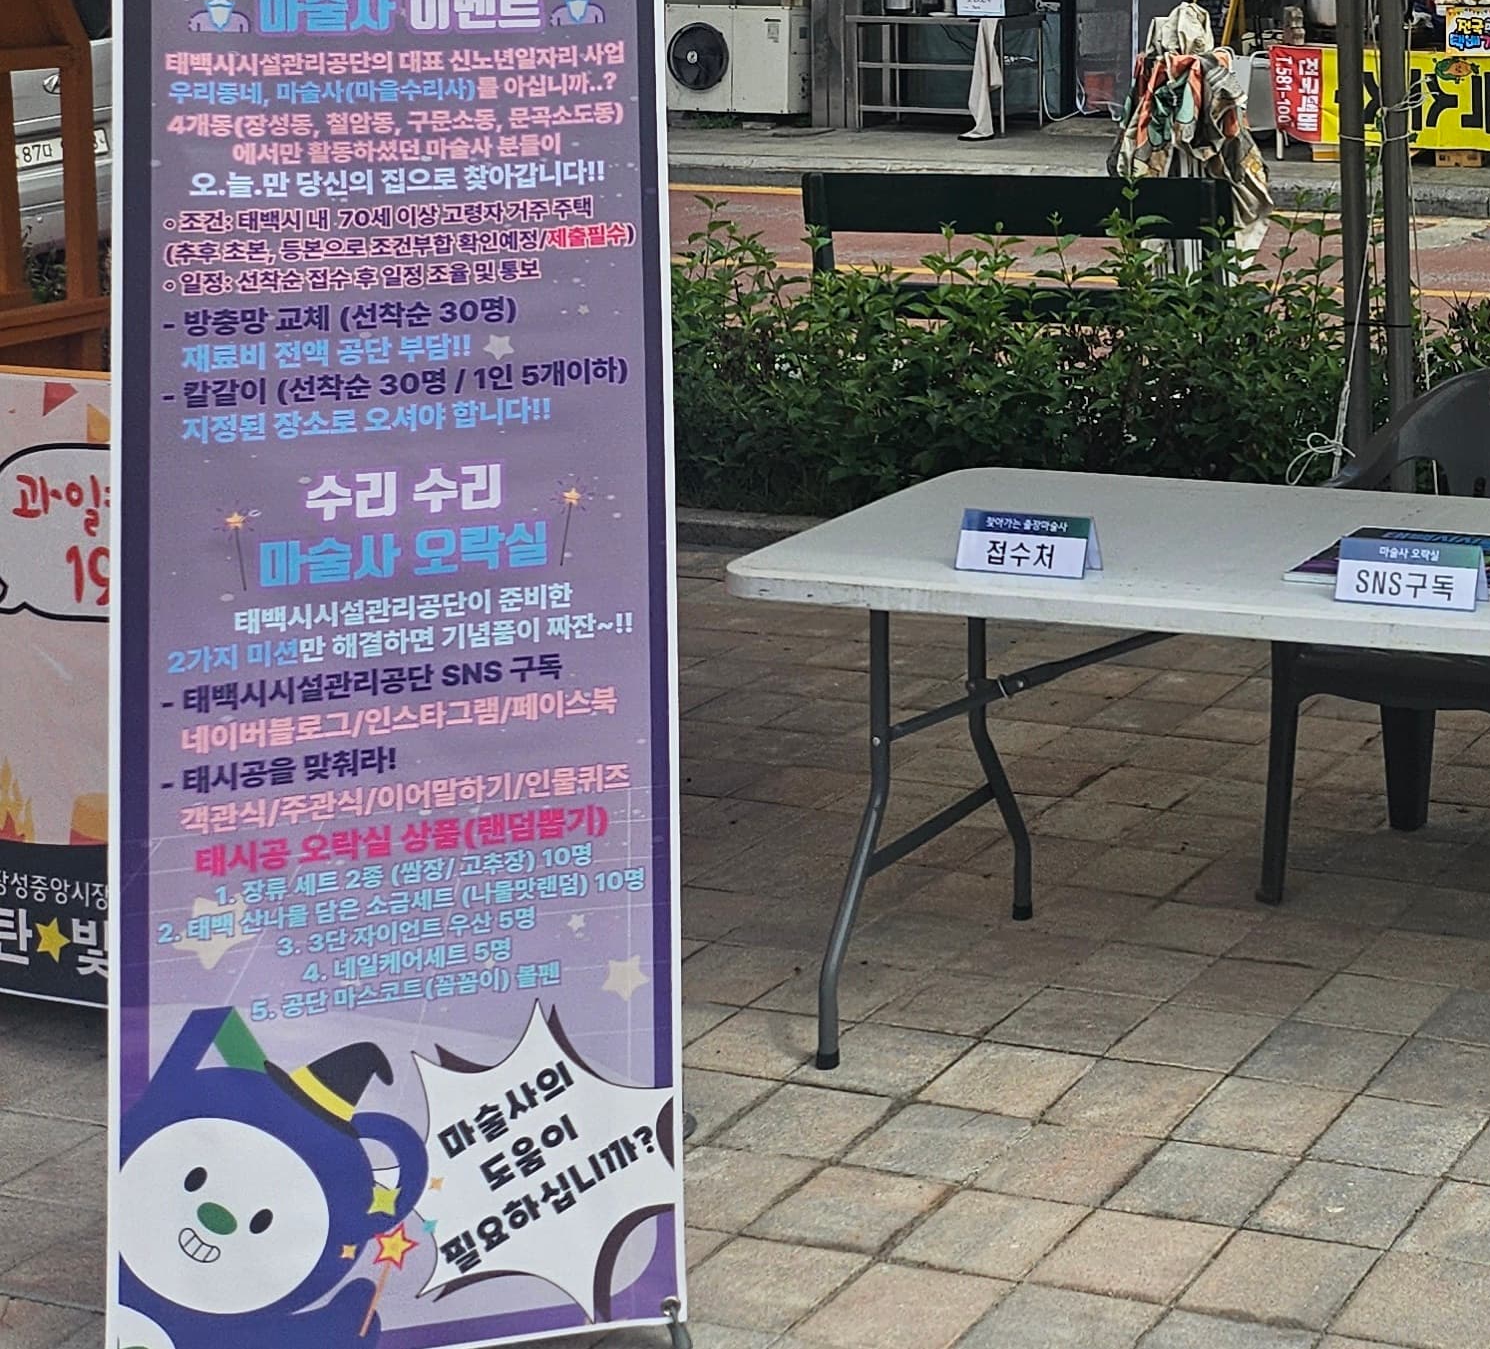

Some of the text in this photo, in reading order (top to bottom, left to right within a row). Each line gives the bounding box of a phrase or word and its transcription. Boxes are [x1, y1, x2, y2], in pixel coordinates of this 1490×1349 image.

[165, 41, 625, 77] 태백시시설관리공단의 대표 신노년일자리 사업
[168, 72, 617, 107] 우리동네, 마술사(마을수리사)를 아십니까..?
[1274, 56, 1295, 128] T.581-100
[166, 102, 624, 138] 4개동(장성동, 철암동, 구문소동, 문곡소도동)
[232, 133, 561, 166] 에서만 활동하셨던 마술사 분들이
[189, 159, 606, 198] 오.늘.만 당신의 집으로 찾아갑니다!!
[179, 195, 593, 233] 조건: 태백시 70세 이상 고령자 주택
[165, 223, 637, 266] (추후 초본, 등본으로 조건부합 확인예정/제출필수)
[180, 258, 541, 295] 일정: 선착순 접수 조율 통보
[183, 295, 517, 337] 방충망 교체 (선착순 30명)
[181, 333, 471, 373] 재료비 전액 공단 부담!!
[183, 356, 628, 408] 칼갈이 (선착순 30명 1인 5개이하)
[181, 396, 551, 444] 지정된 장소로 오셔야 합니다!!
[12, 474, 110, 537] 과일
[305, 463, 501, 522] 수리 수리
[259, 521, 548, 588] 마술사 오락실
[987, 540, 1055, 569] 접수처
[1379, 545, 1409, 560] 마술사
[234, 582, 573, 634] 태백시시설관리공단이 준비한
[1356, 569, 1454, 602] SNS구독
[167, 612, 634, 674] 2가지 미션만 해결하면 기념품이 짜잔~!!
[182, 653, 563, 714] 태백시시설관리공단 SNS 구독
[182, 746, 396, 794] 태시공을 맞춰라!
[195, 803, 609, 878] 태시공 오락실 상품(랜덤뽑기)
[242, 877, 288, 904] 장류
[294, 871, 339, 896] 세트
[345, 865, 384, 890] 2종
[460, 851, 535, 877] 고추장)
[542, 843, 592, 868] 10명
[186, 873, 588, 941] 태백 산나물 담은 소금세트 (나물맛랜덤)
[308, 911, 492, 953] 3단 자이언트 우산
[334, 937, 512, 979] 네일케어세트 5명
[282, 961, 561, 1018] 공단 마스코트(꼼꼼이) 볼펜
[437, 1060, 575, 1159] 마술사의
[479, 1114, 578, 1192] 도움이
[439, 1125, 655, 1274] 필요하십니까?
